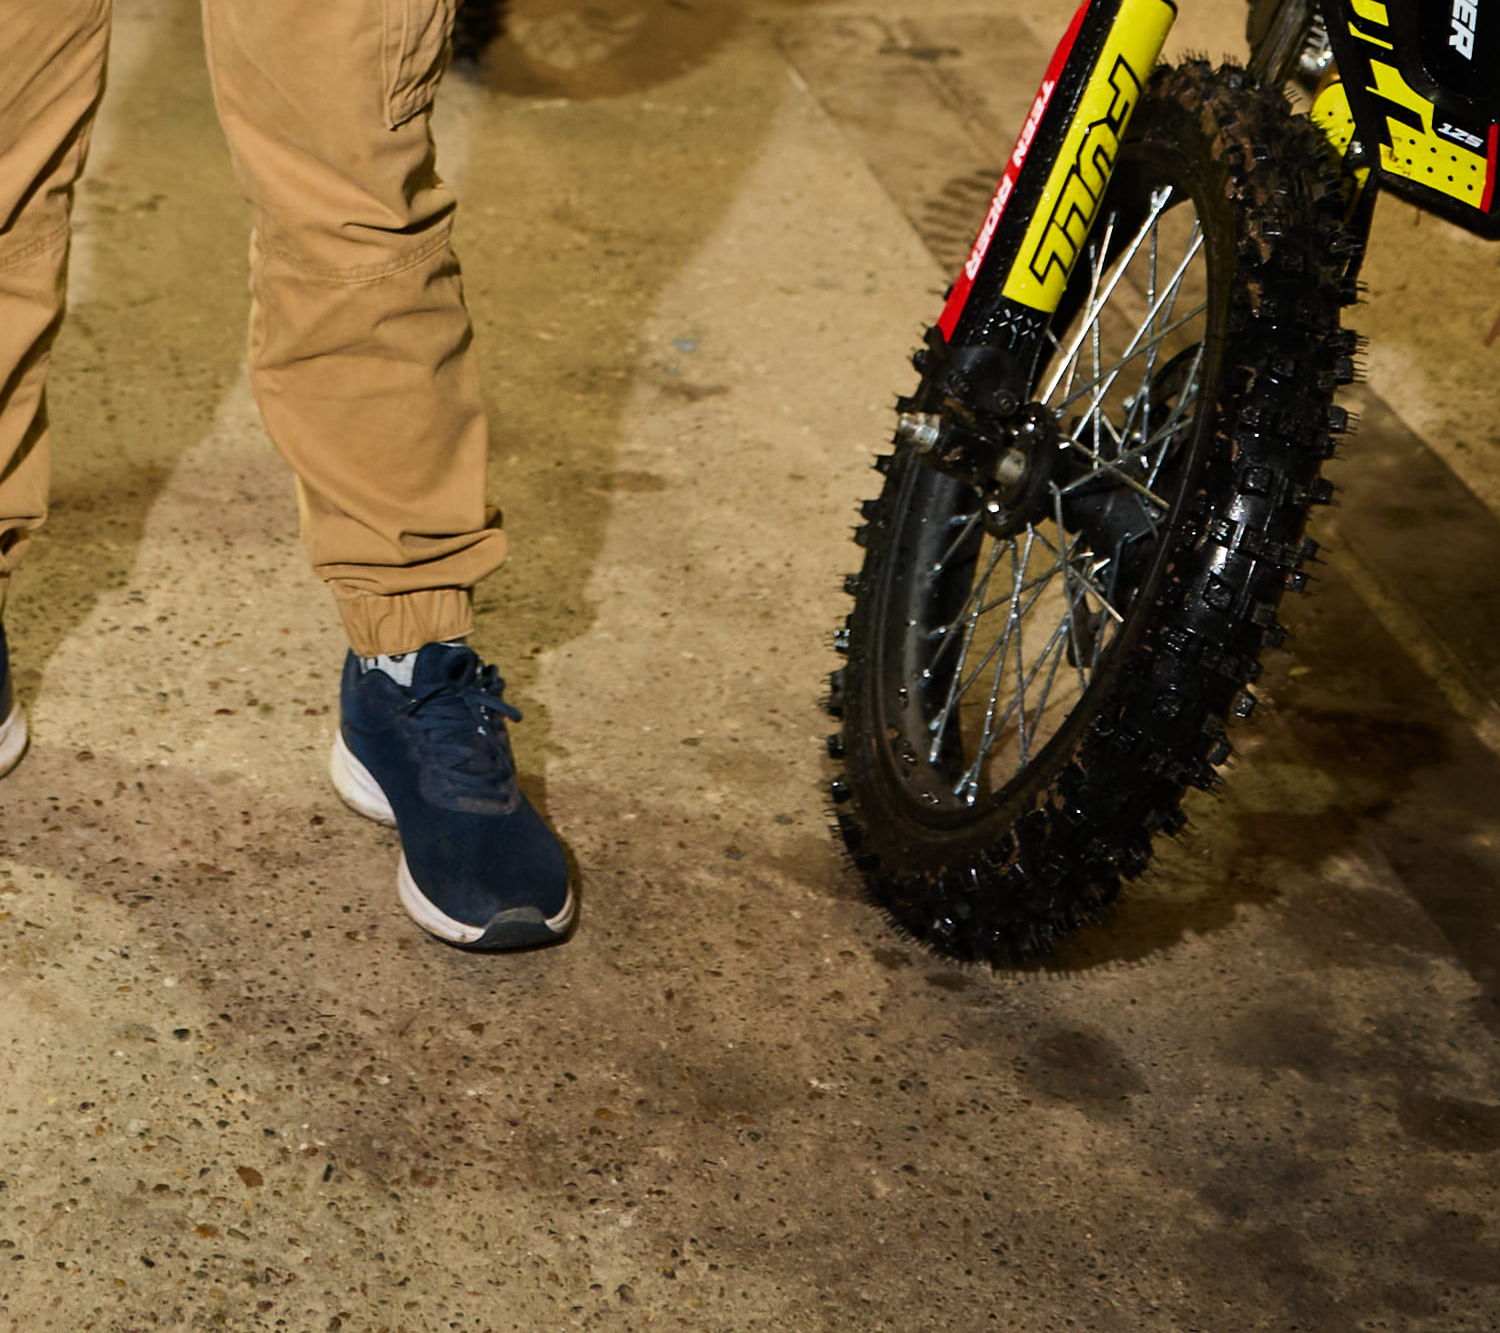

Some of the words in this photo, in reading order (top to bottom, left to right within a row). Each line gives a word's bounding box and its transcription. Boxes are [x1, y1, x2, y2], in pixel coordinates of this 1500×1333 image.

[1013, 80, 1055, 168] TEEN
[1029, 52, 1144, 286] FULL
[1437, 121, 1485, 149] 125
[965, 173, 1013, 282] RIDER
